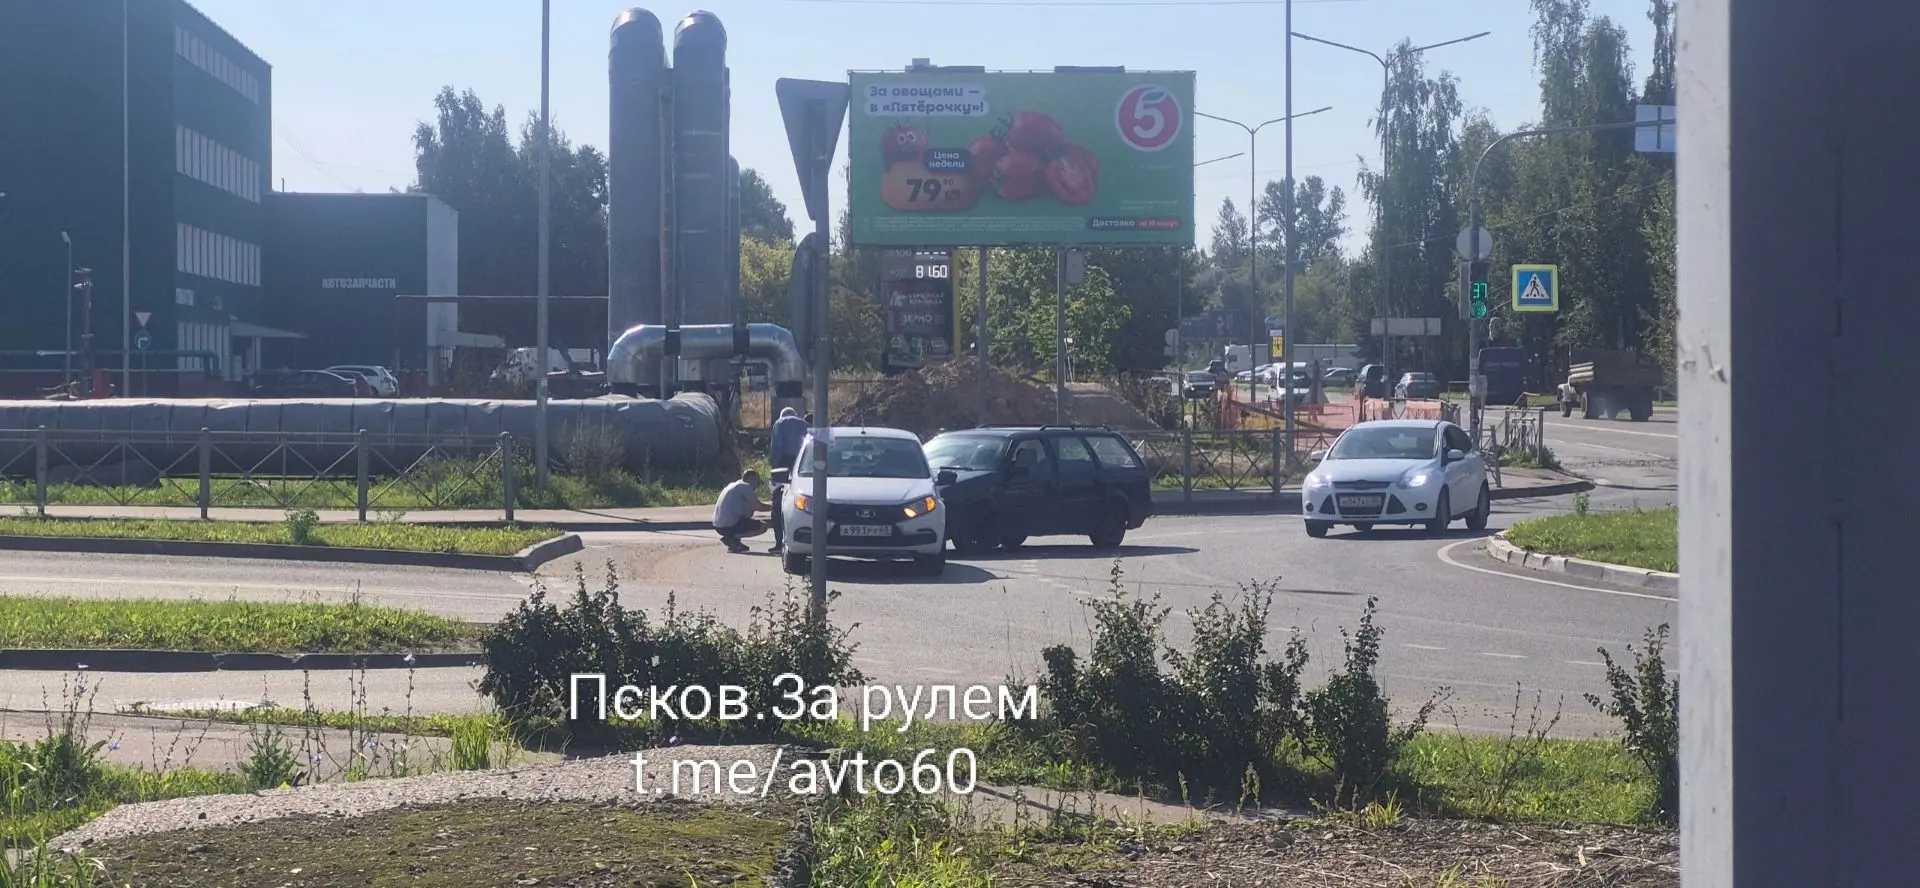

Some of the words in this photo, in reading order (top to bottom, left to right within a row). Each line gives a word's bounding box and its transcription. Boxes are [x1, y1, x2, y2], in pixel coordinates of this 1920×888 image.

[870, 86, 887, 97] За
[892, 87, 963, 98] овощами
[870, 104, 878, 112] в
[883, 101, 984, 115] «Пятёрочку»!
[1132, 91, 1164, 139] 5
[934, 151, 959, 160] Цена
[928, 160, 965, 168] недели
[906, 178, 942, 203] 79
[1092, 219, 1135, 229] Доставка
[915, 265, 947, 279] 81.60
[322, 277, 396, 289] АВТОЗАПЧАСТИ
[1473, 282, 1487, 299] 37
